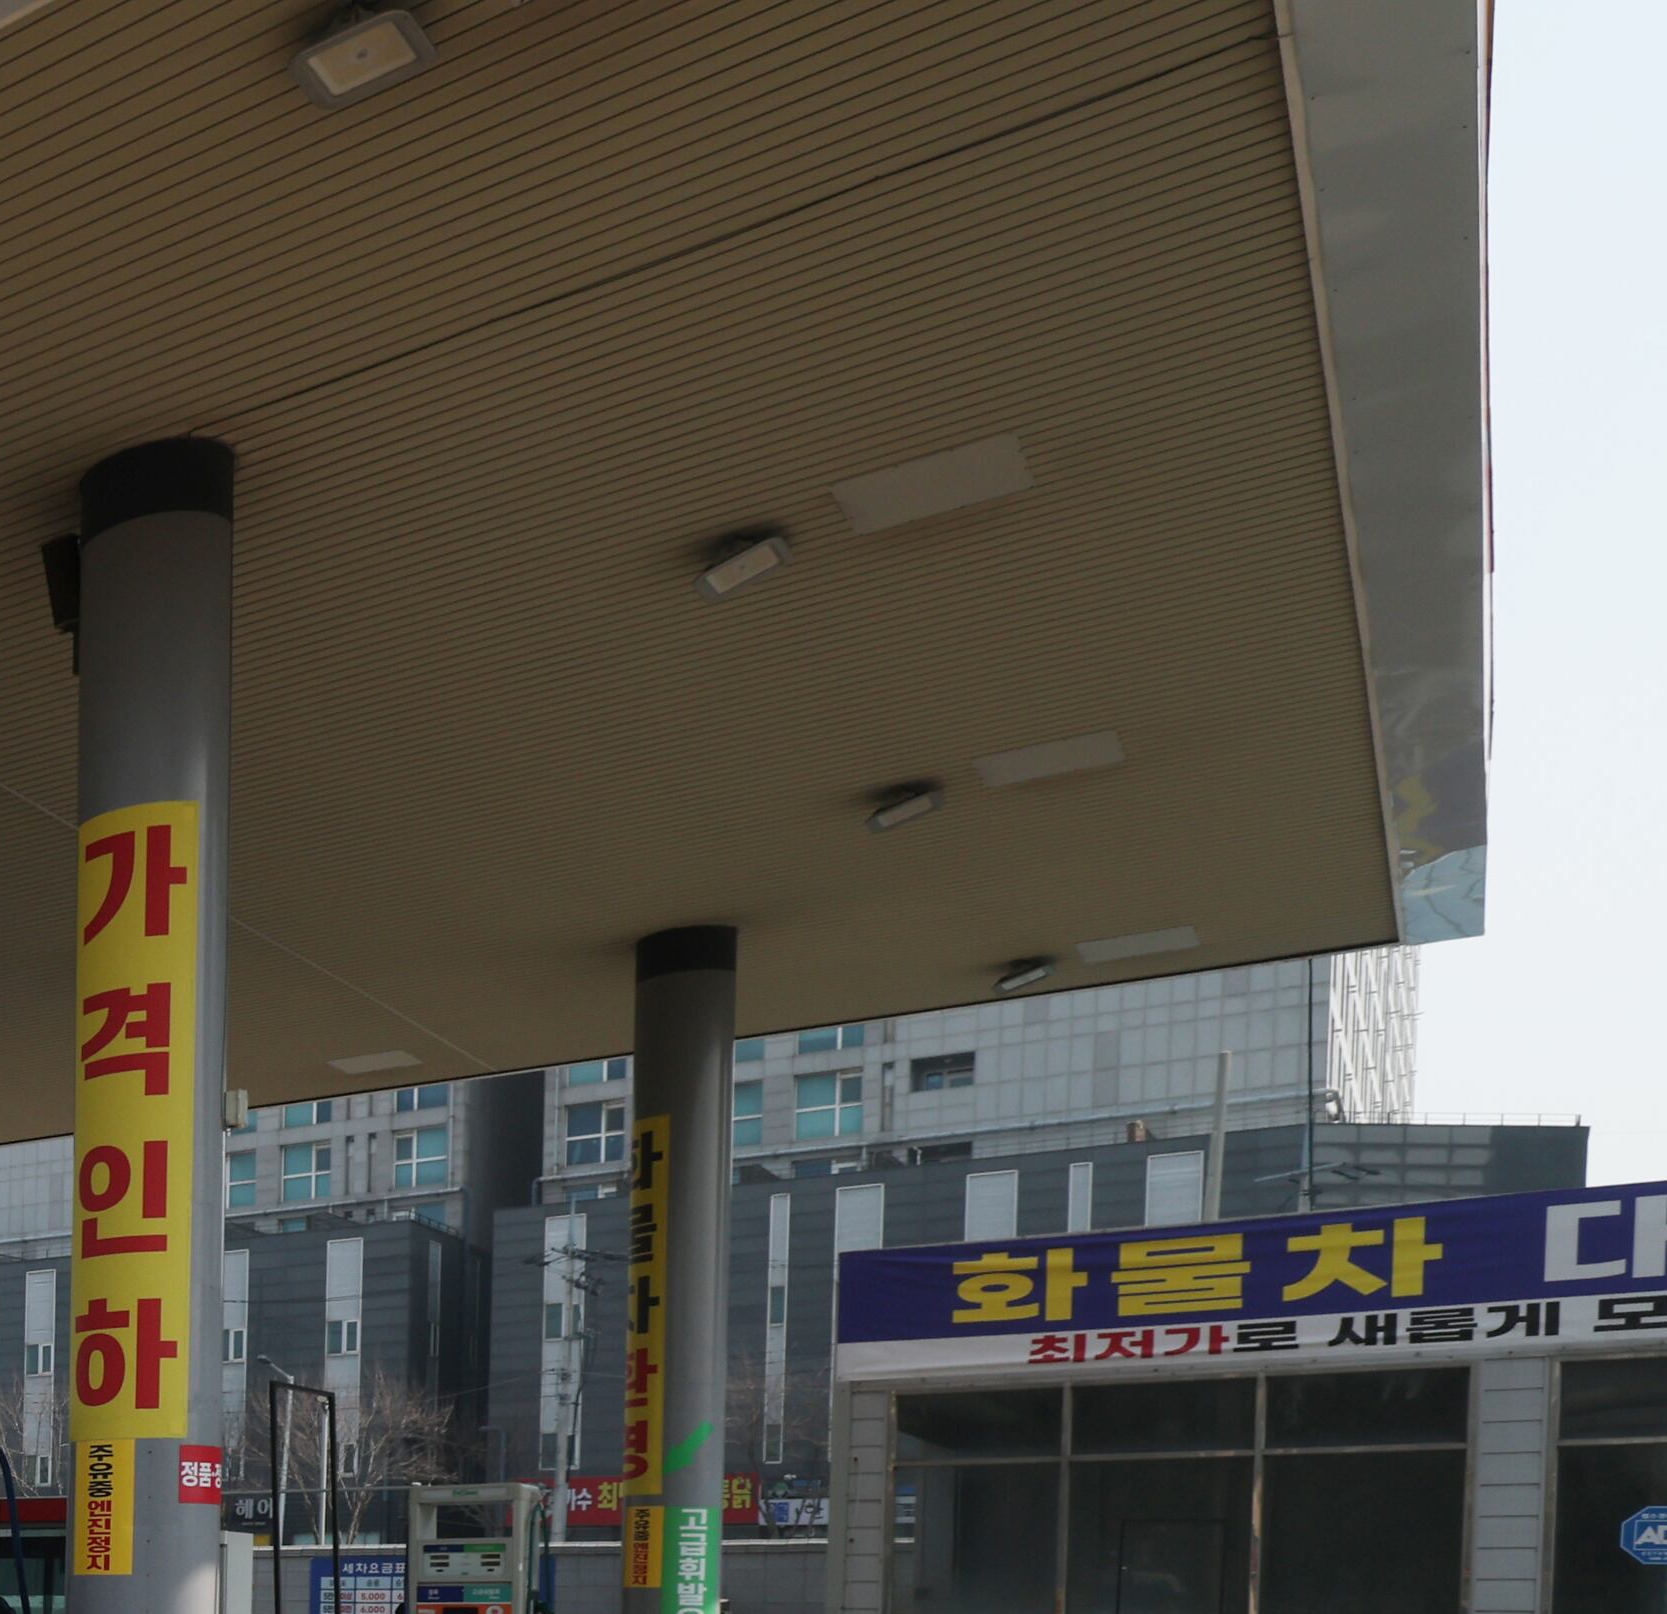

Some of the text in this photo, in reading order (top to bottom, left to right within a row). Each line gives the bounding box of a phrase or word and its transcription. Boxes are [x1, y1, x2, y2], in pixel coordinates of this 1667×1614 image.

[952, 1216, 1443, 1324] 화물차
[1028, 1320, 1299, 1365] 최저가로
[1327, 1301, 1561, 1347] 새롭게
[86, 1444, 114, 1571] 주유중 엔진정지
[342, 1562, 406, 1574] 세차요금표
